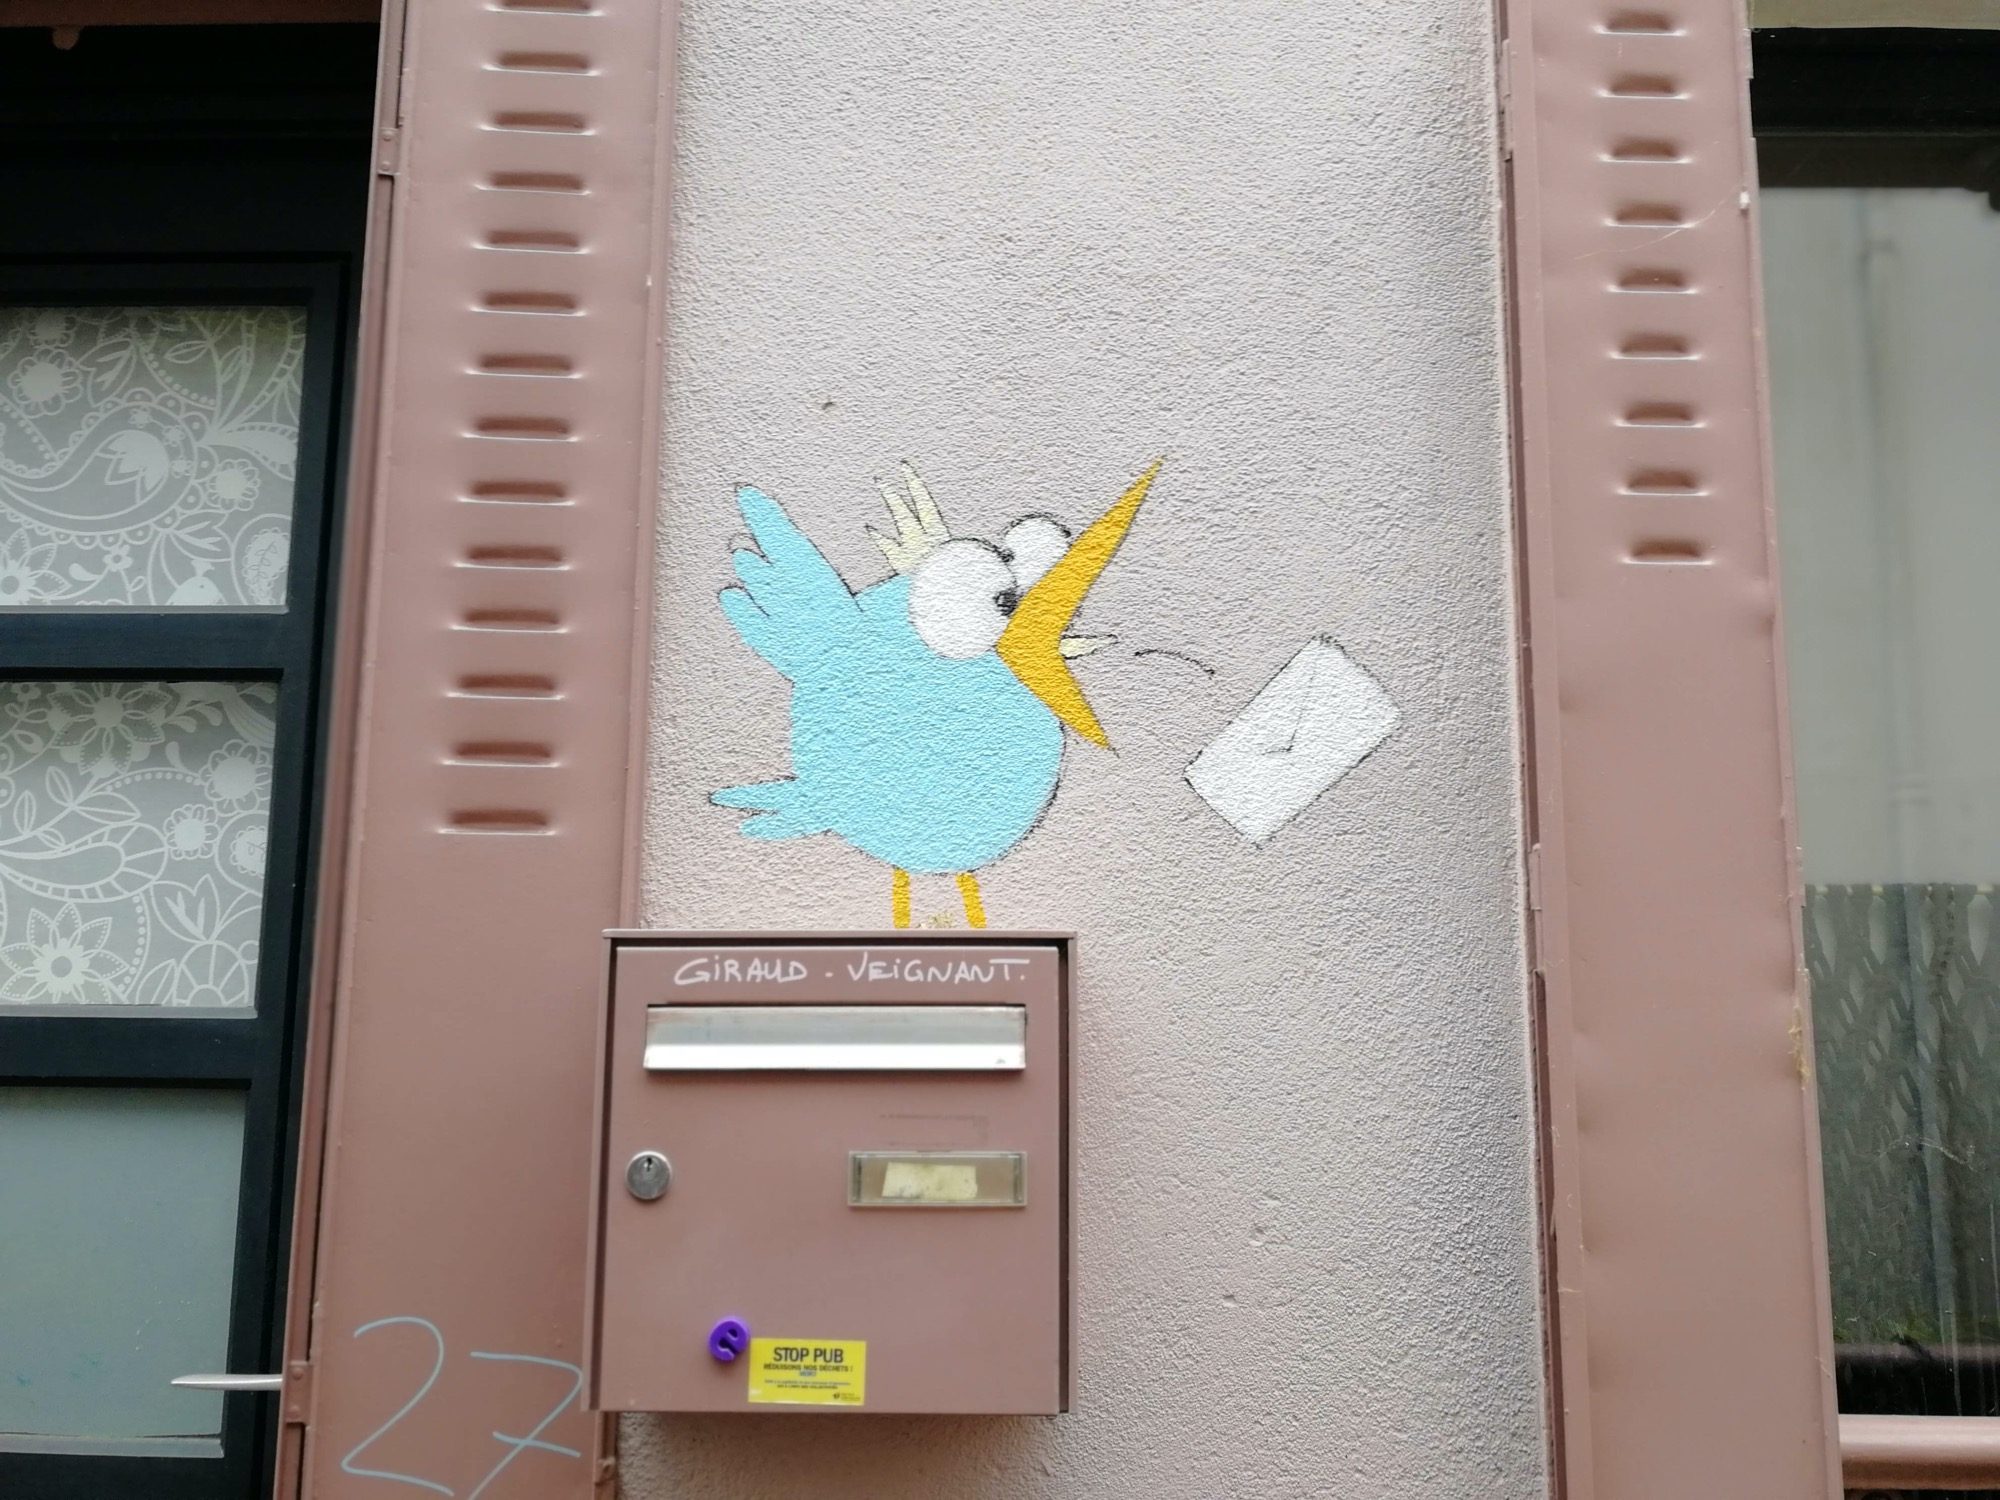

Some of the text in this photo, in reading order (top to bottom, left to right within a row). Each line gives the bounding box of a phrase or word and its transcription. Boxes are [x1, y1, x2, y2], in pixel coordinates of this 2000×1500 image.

[773, 1347, 844, 1364] STOP PUB
[341, 1316, 584, 1500] 27
